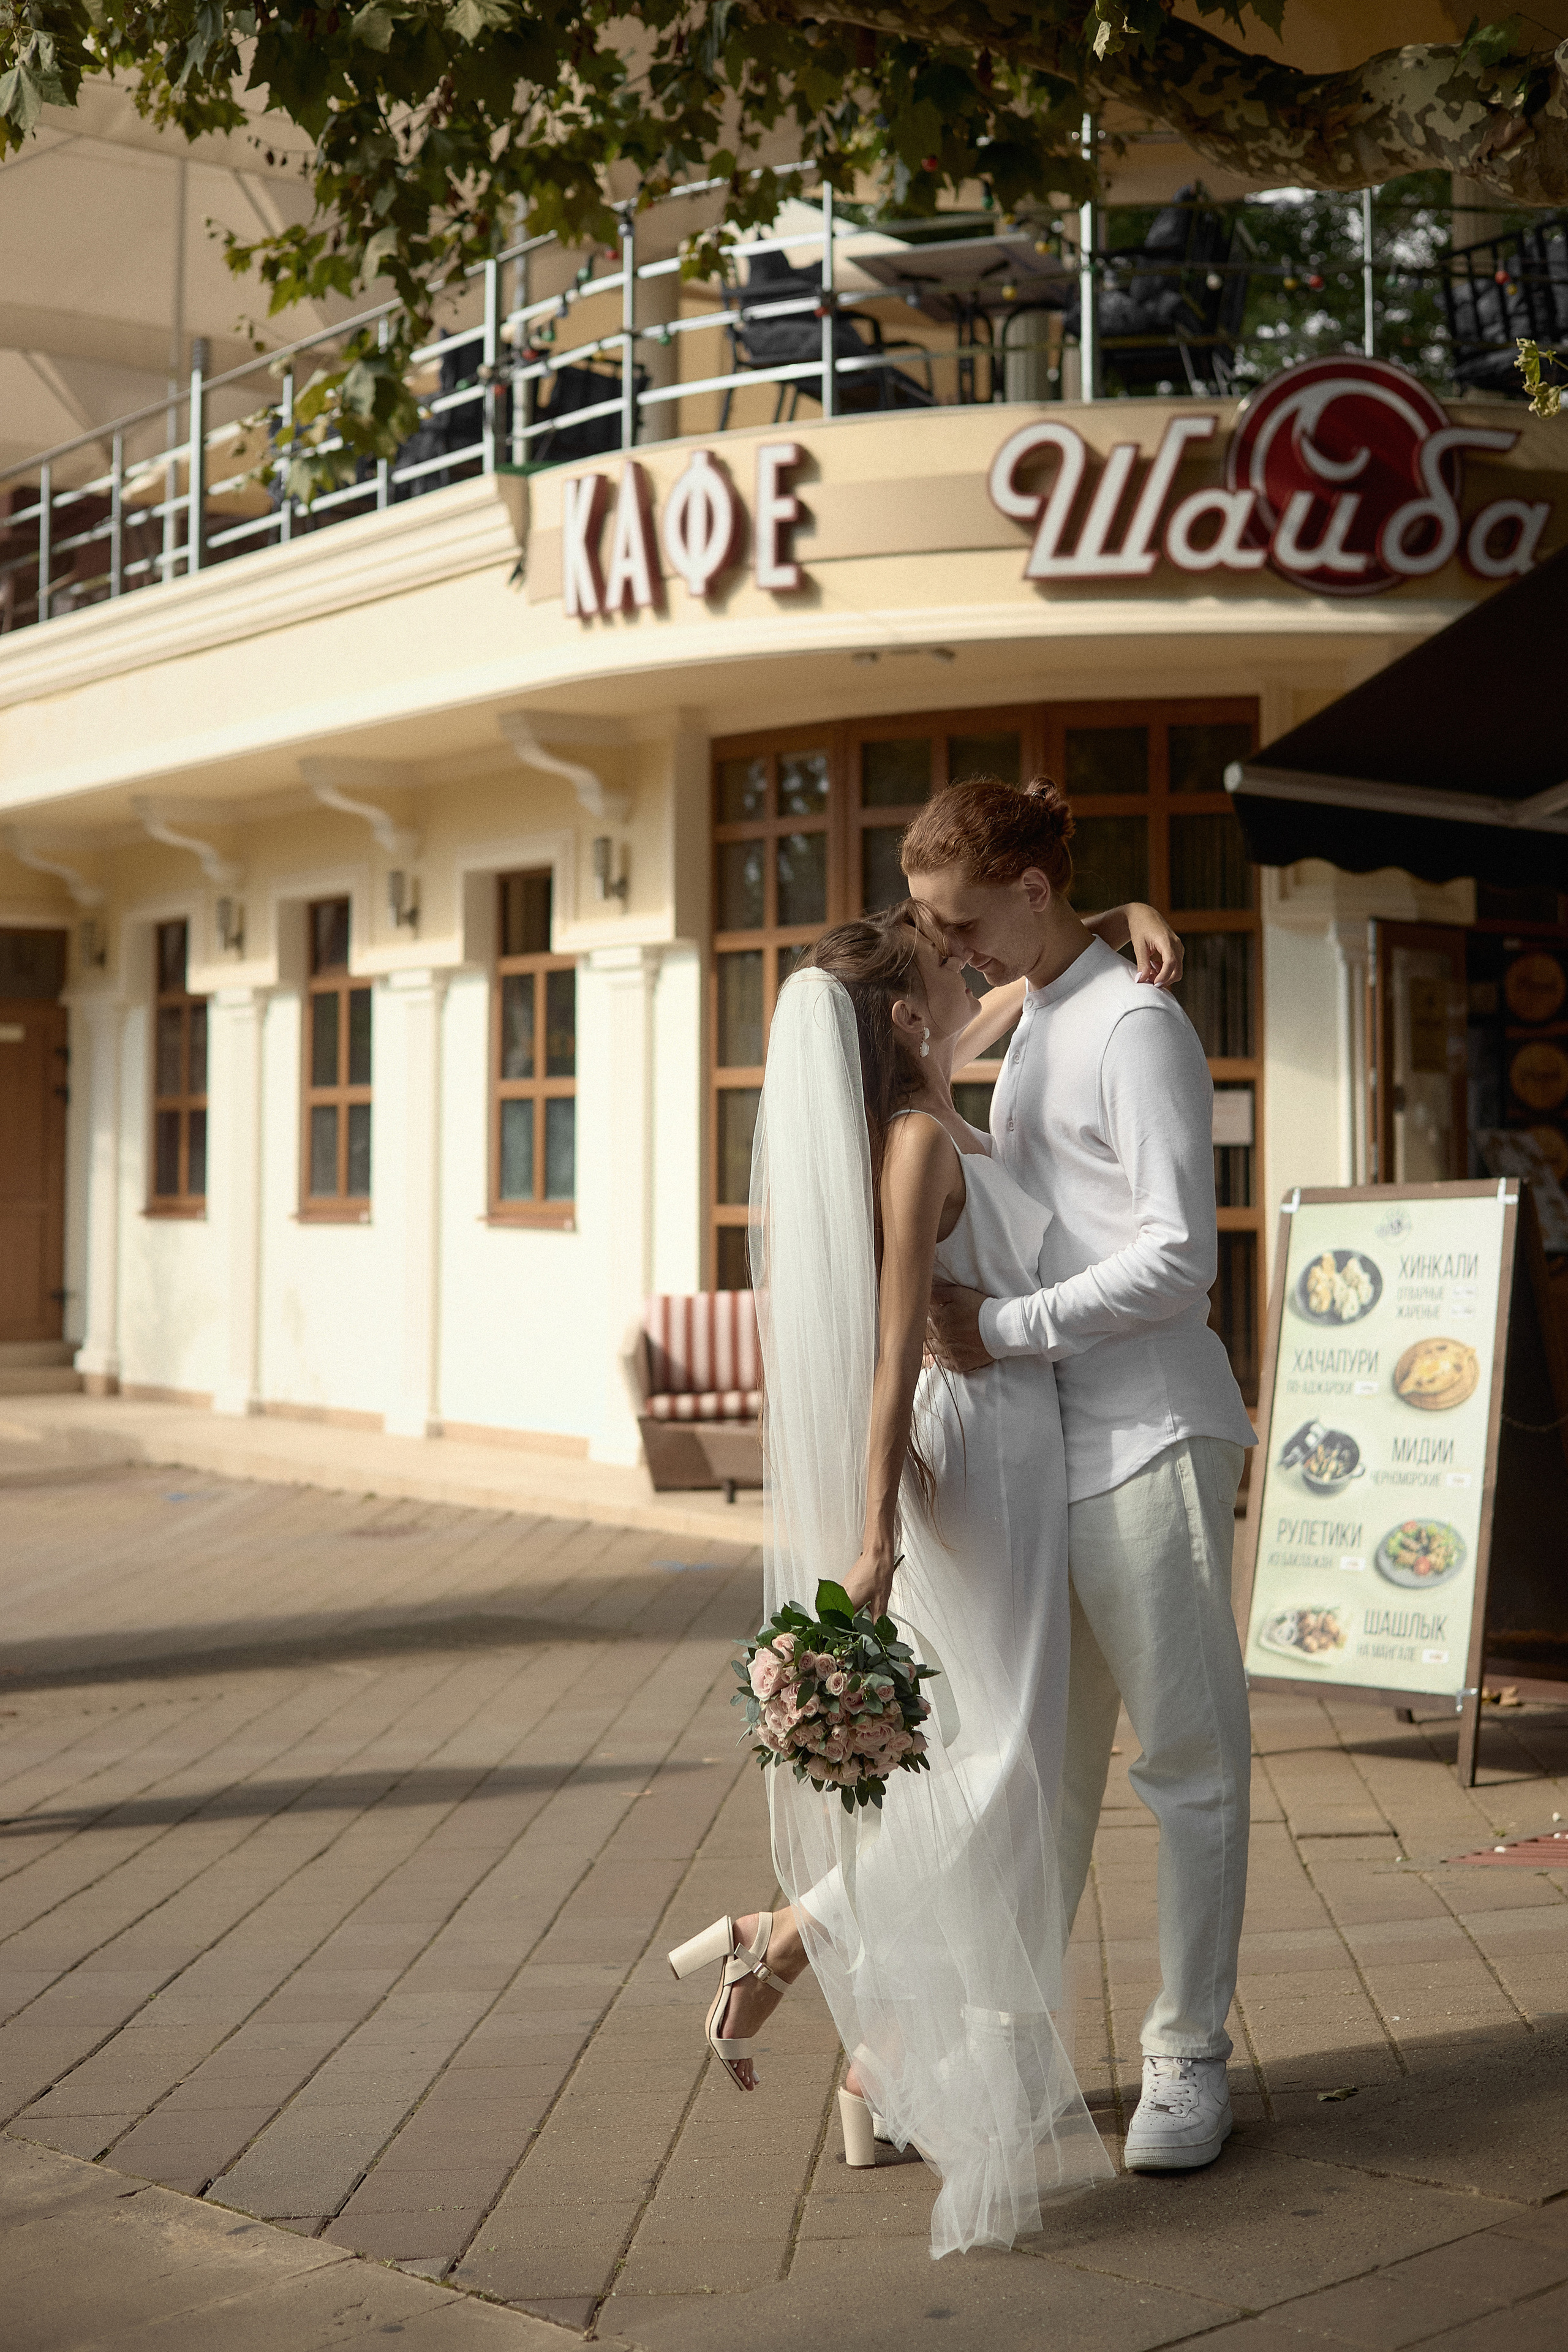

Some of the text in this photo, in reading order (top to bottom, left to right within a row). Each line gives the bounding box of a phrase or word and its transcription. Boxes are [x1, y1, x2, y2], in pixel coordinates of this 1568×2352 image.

[562, 442, 801, 617] КАФЕ
[1398, 1253, 1479, 1280] ХИНКАЛИ
[1292, 1348, 1379, 1373] ХАЧАПУРИ
[1391, 1437, 1455, 1464] МИДИИ
[1276, 1518, 1363, 1548] РУЛЕТИКИ
[1363, 1609, 1448, 1642] ШАШЛЫК
